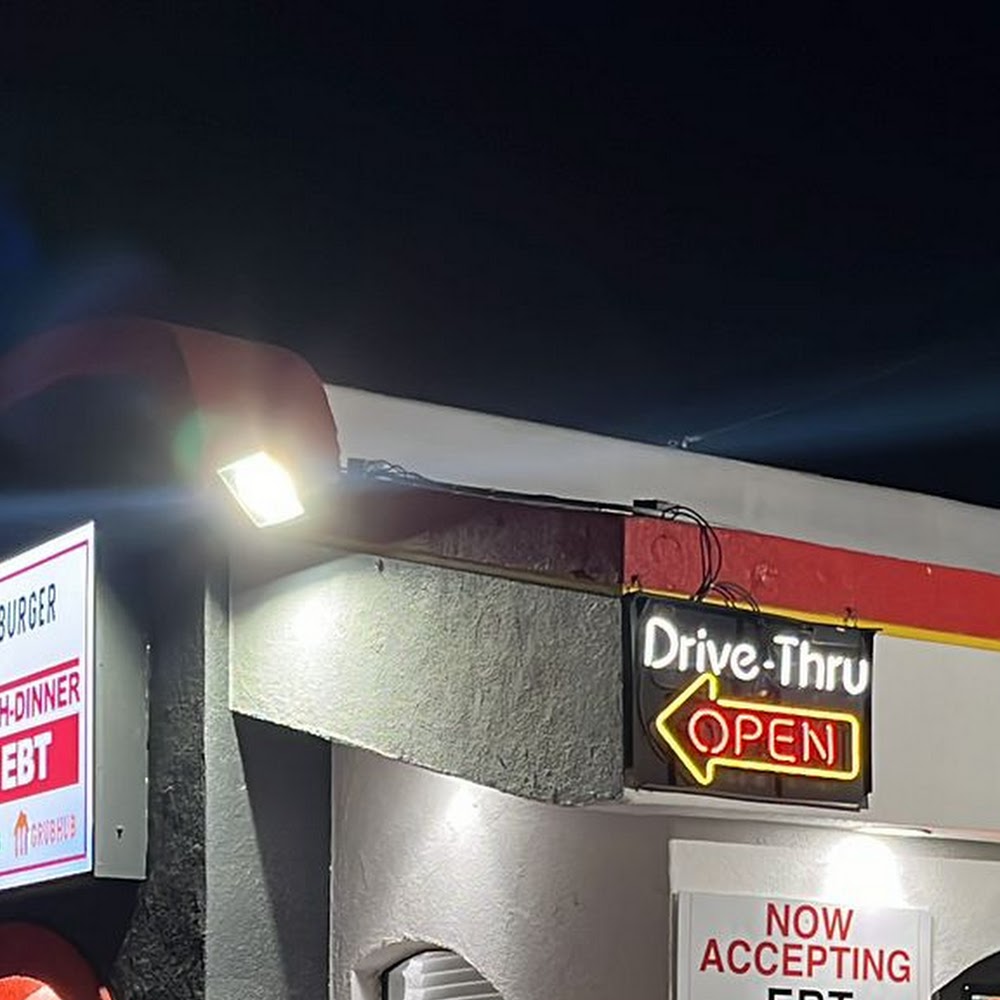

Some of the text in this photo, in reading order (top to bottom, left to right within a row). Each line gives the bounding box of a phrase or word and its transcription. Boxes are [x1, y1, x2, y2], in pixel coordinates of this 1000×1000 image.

[0, 583, 56, 642] BURGER
[643, 616, 868, 695] Drive-Thru
[1, 730, 53, 792] EBT
[688, 709, 834, 766] OPEN
[766, 903, 854, 941] NOW
[699, 938, 911, 983] ACCEPTING
